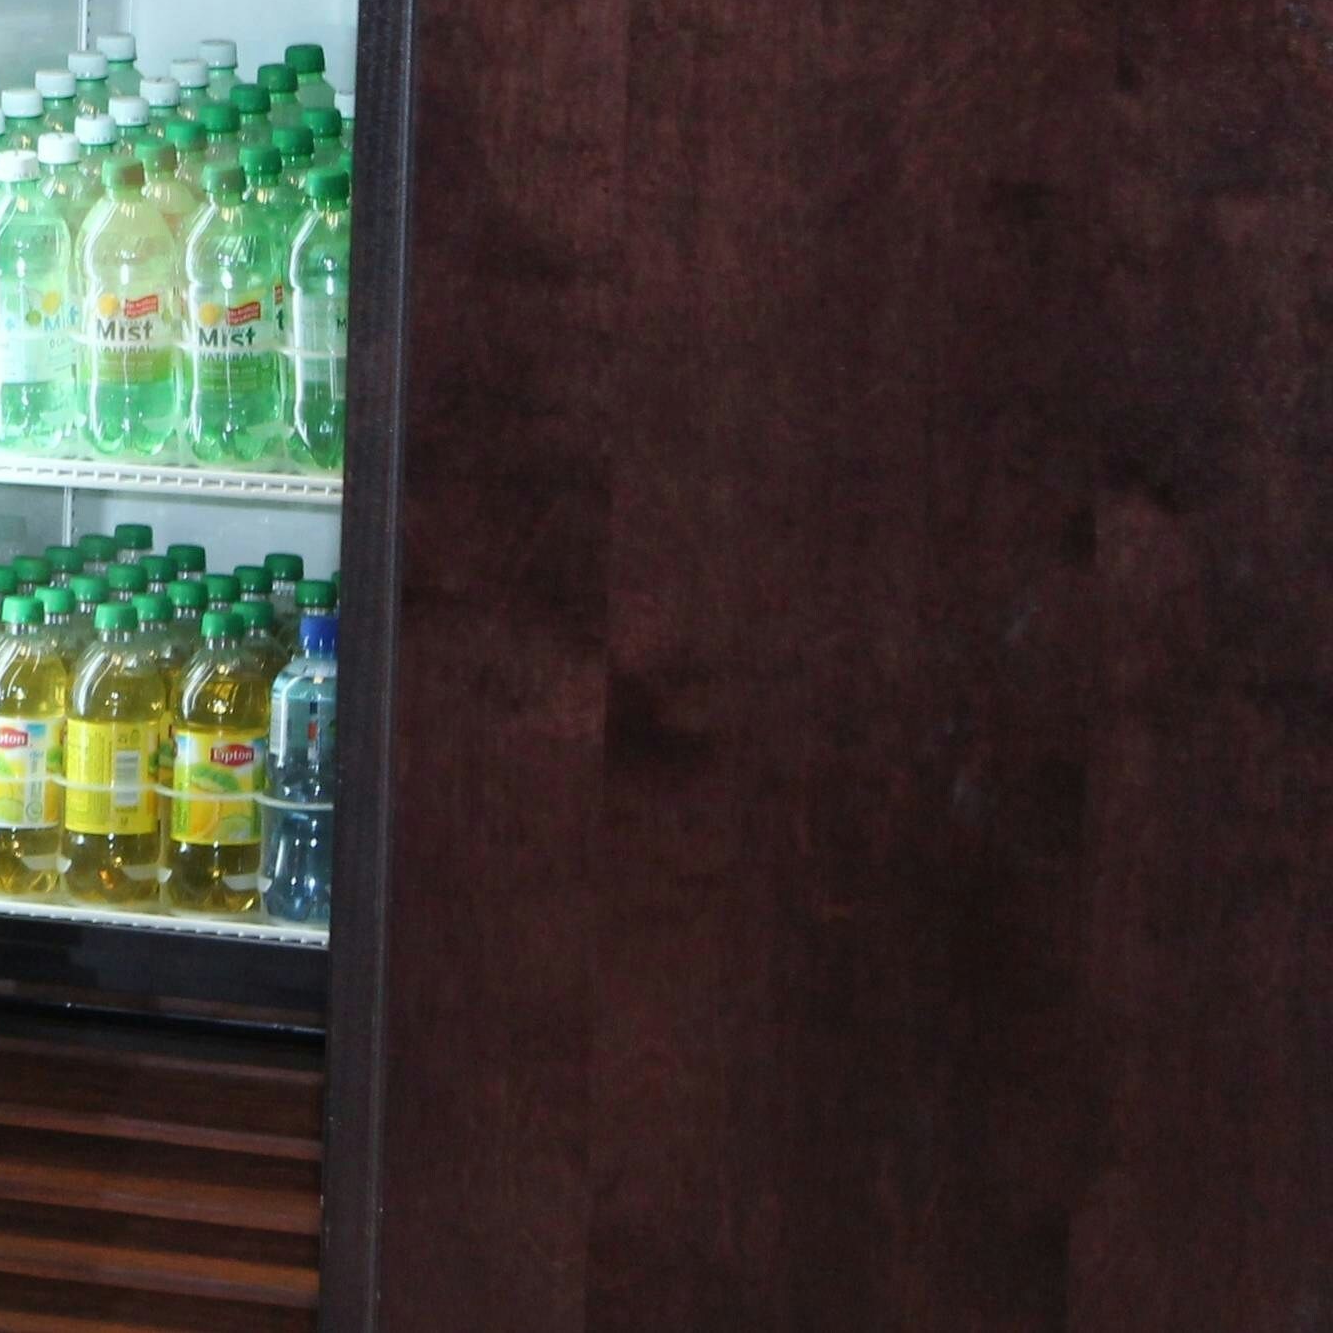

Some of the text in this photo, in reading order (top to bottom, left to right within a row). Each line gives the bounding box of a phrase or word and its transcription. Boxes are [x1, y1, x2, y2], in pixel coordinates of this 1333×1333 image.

[97, 319, 153, 341] Mist
[199, 328, 255, 347] Mist
[213, 747, 253, 764] Lipton
